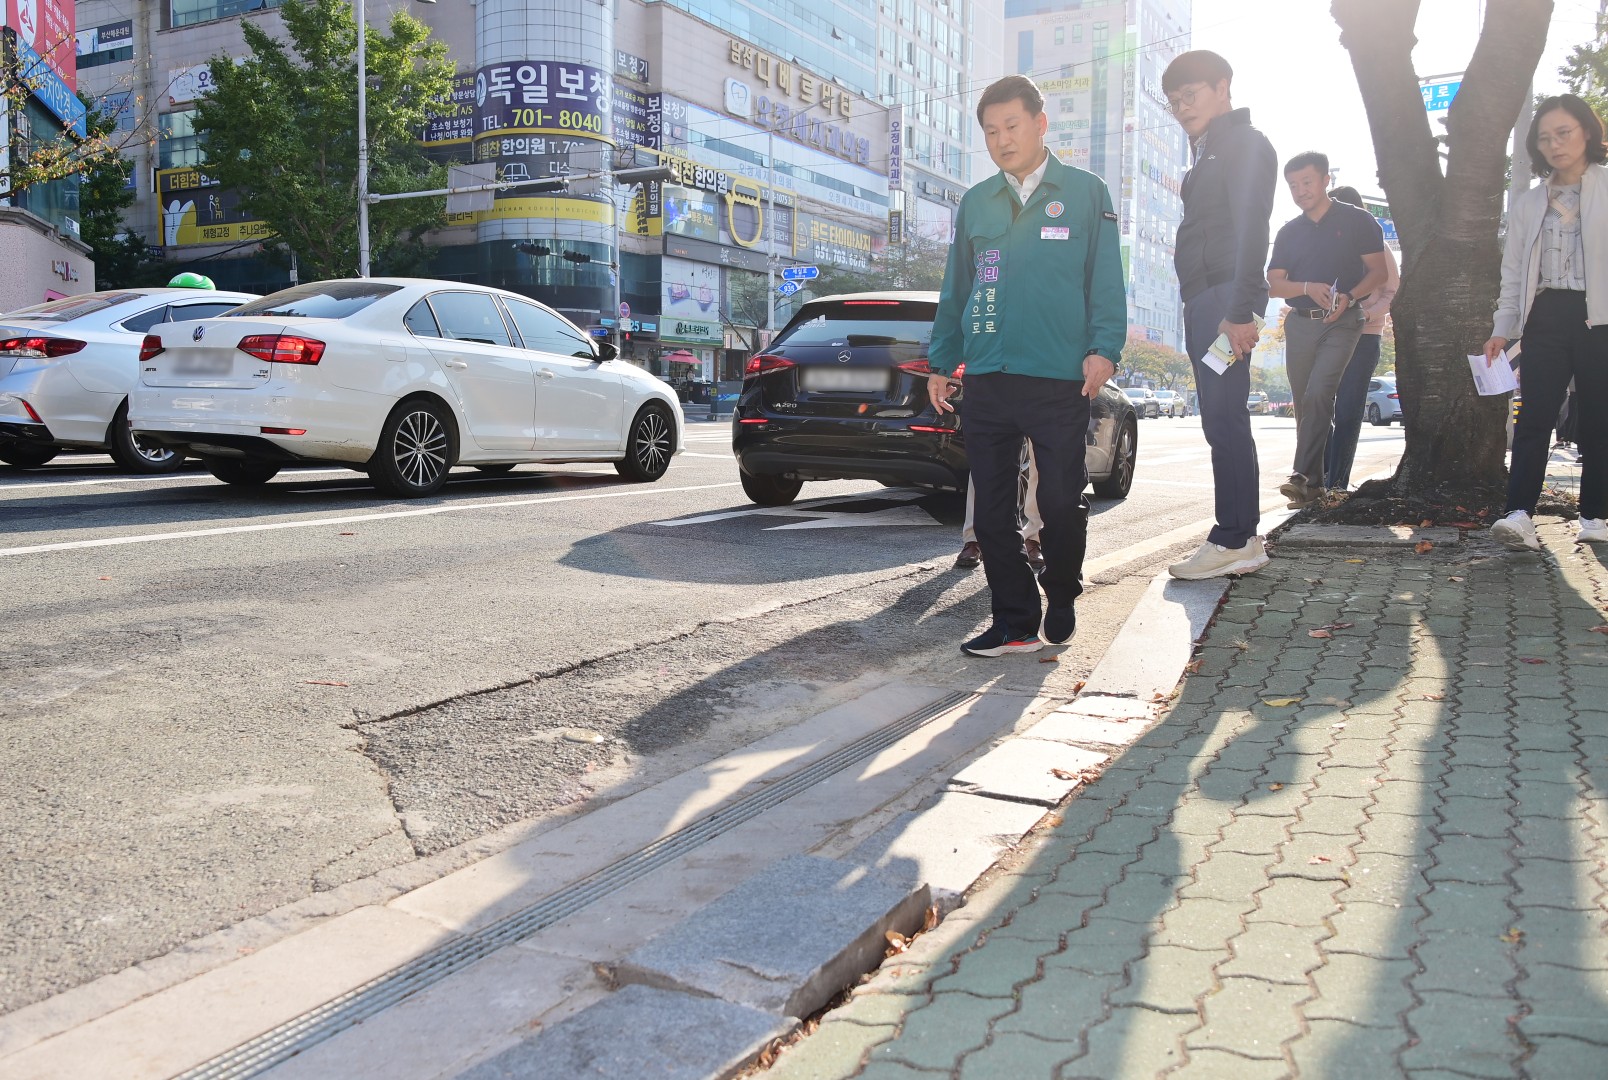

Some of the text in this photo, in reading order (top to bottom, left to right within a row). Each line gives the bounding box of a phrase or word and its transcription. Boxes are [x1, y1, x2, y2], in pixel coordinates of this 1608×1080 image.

[617, 51, 648, 78] 보청기
[462, 77, 474, 86] 지원
[488, 64, 613, 113] 독일 보청
[1074, 77, 1090, 88] 치과
[452, 89, 476, 101] 방문상담
[1422, 85, 1450, 102] 실로
[461, 105, 473, 116] A/S
[662, 100, 688, 123] 보청기
[1428, 100, 1449, 109] l-ro
[431, 117, 473, 131] 초소형 보청기
[482, 115, 508, 131] TEL.
[637, 121, 646, 132] A/S
[646, 96, 661, 152] 보청기
[890, 121, 900, 180] 오정세치과
[549, 161, 570, 174] 디스
[650, 182, 658, 215] 한의원
[203, 226, 230, 239] 체형교정
[985, 249, 1000, 283] 구민
[972, 289, 982, 334] 속으로
